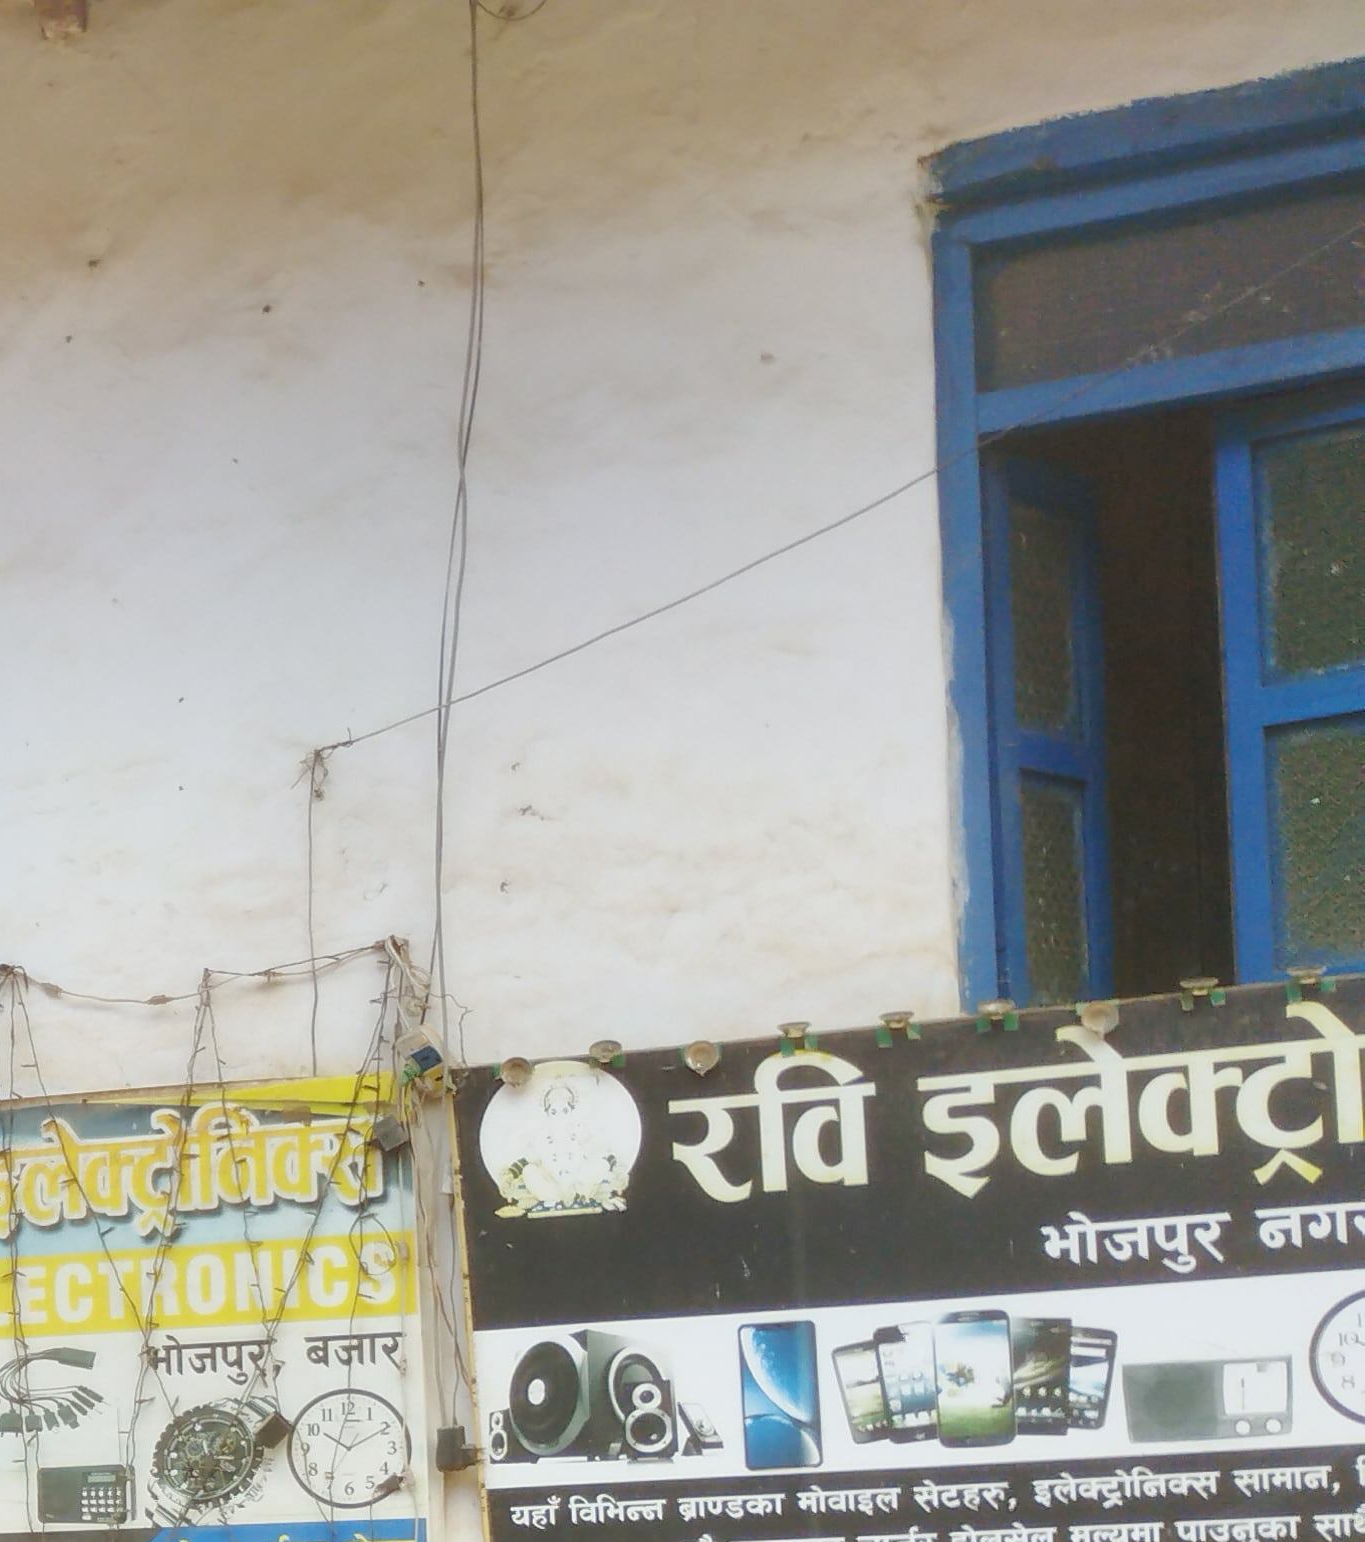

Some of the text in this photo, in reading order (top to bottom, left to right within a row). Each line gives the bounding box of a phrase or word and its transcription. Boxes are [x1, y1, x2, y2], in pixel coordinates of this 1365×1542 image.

[669, 1050, 876, 1203] रवि
[1041, 1211, 1231, 1274] भोजपुर
[304, 1331, 406, 1373] बजार
[322, 1407, 333, 1422] 11
[341, 1402, 356, 1416] 12
[367, 1407, 373, 1421] 1
[307, 1423, 320, 1437] 10
[381, 1421, 391, 1435] 2
[387, 1441, 397, 1455] 3
[308, 1462, 318, 1476] 8
[379, 1462, 390, 1476] 4
[344, 1481, 355, 1496] 6
[365, 1476, 376, 1490] 5
[510, 1495, 560, 1531] यहाँ
[568, 1494, 667, 1526] विभिन्न
[677, 1493, 786, 1520] ब्राण्डका
[797, 1484, 901, 1517] मोवाइल
[1032, 1466, 1220, 1509] इलेक्ट्रोनिक्स
[1231, 1464, 1341, 1498] सामान,
